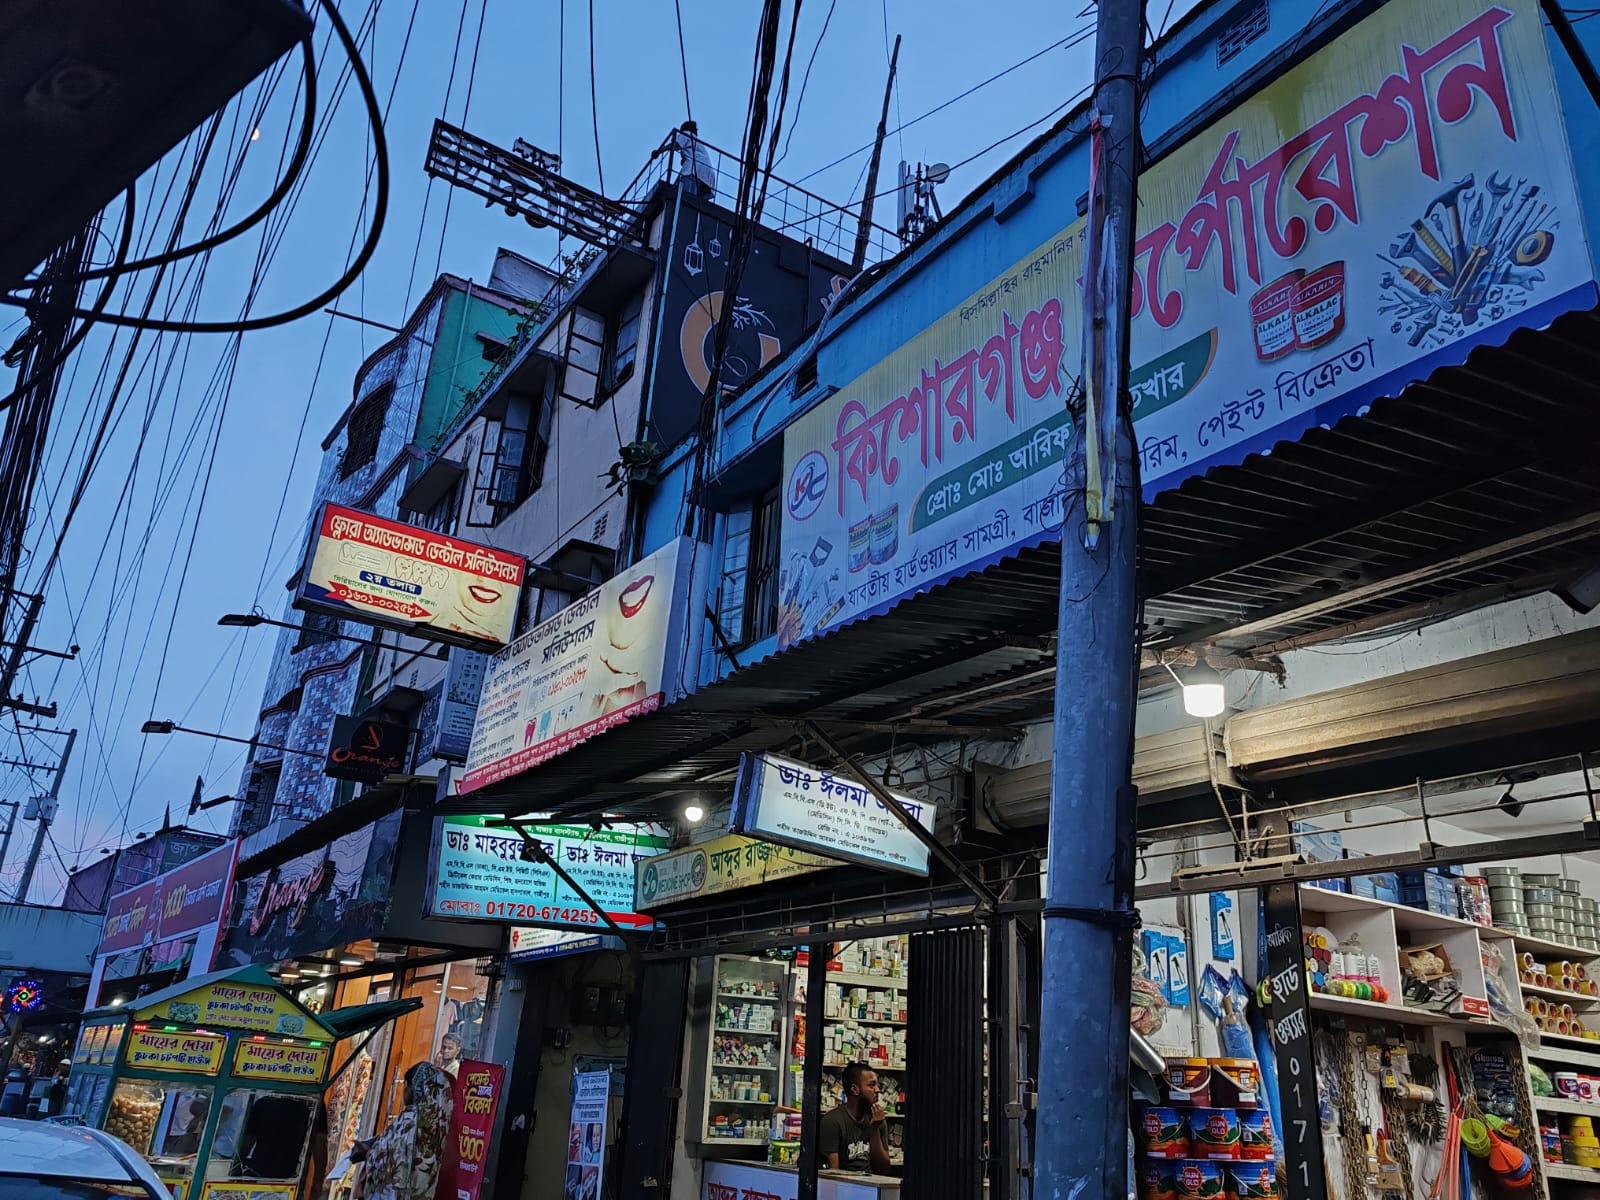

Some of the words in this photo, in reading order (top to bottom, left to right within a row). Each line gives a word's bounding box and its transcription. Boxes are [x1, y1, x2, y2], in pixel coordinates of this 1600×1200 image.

[830, 297, 1065, 506] কিশোরগঞ্জ
[1075, 7, 1514, 329] র্পোরেশন
[848, 570, 891, 608] যাবতীয়
[1198, 389, 1266, 449] পেইন্ট
[1273, 337, 1375, 411] বিক্রেতা
[967, 463, 1004, 496] মোঃ
[330, 515, 361, 540] ফ্লোরা
[426, 540, 464, 567] ডেন্টাল
[464, 549, 519, 582] সলিউশনস
[366, 573, 382, 585] ২য়
[385, 579, 416, 594] তলায়
[541, 620, 596, 665] সলিউশনস
[778, 763, 812, 791] ডাঃ
[446, 830, 469, 852] ডাঃ
[566, 845, 589, 865] ডাঃ
[710, 846, 742, 879] আব্দুর
[439, 899, 481, 914] মোবাঃ
[486, 900, 599, 924] 01720-674255
[211, 986, 245, 1001] মায়ের
[250, 990, 277, 1003] দোয়া
[139, 1034, 178, 1050] মায়ের
[182, 1038, 215, 1052] দোয়া
[247, 1046, 285, 1061] মায়ের
[288, 1049, 318, 1063] দোয়া
[463, 1088, 493, 1114] বিকাশ
